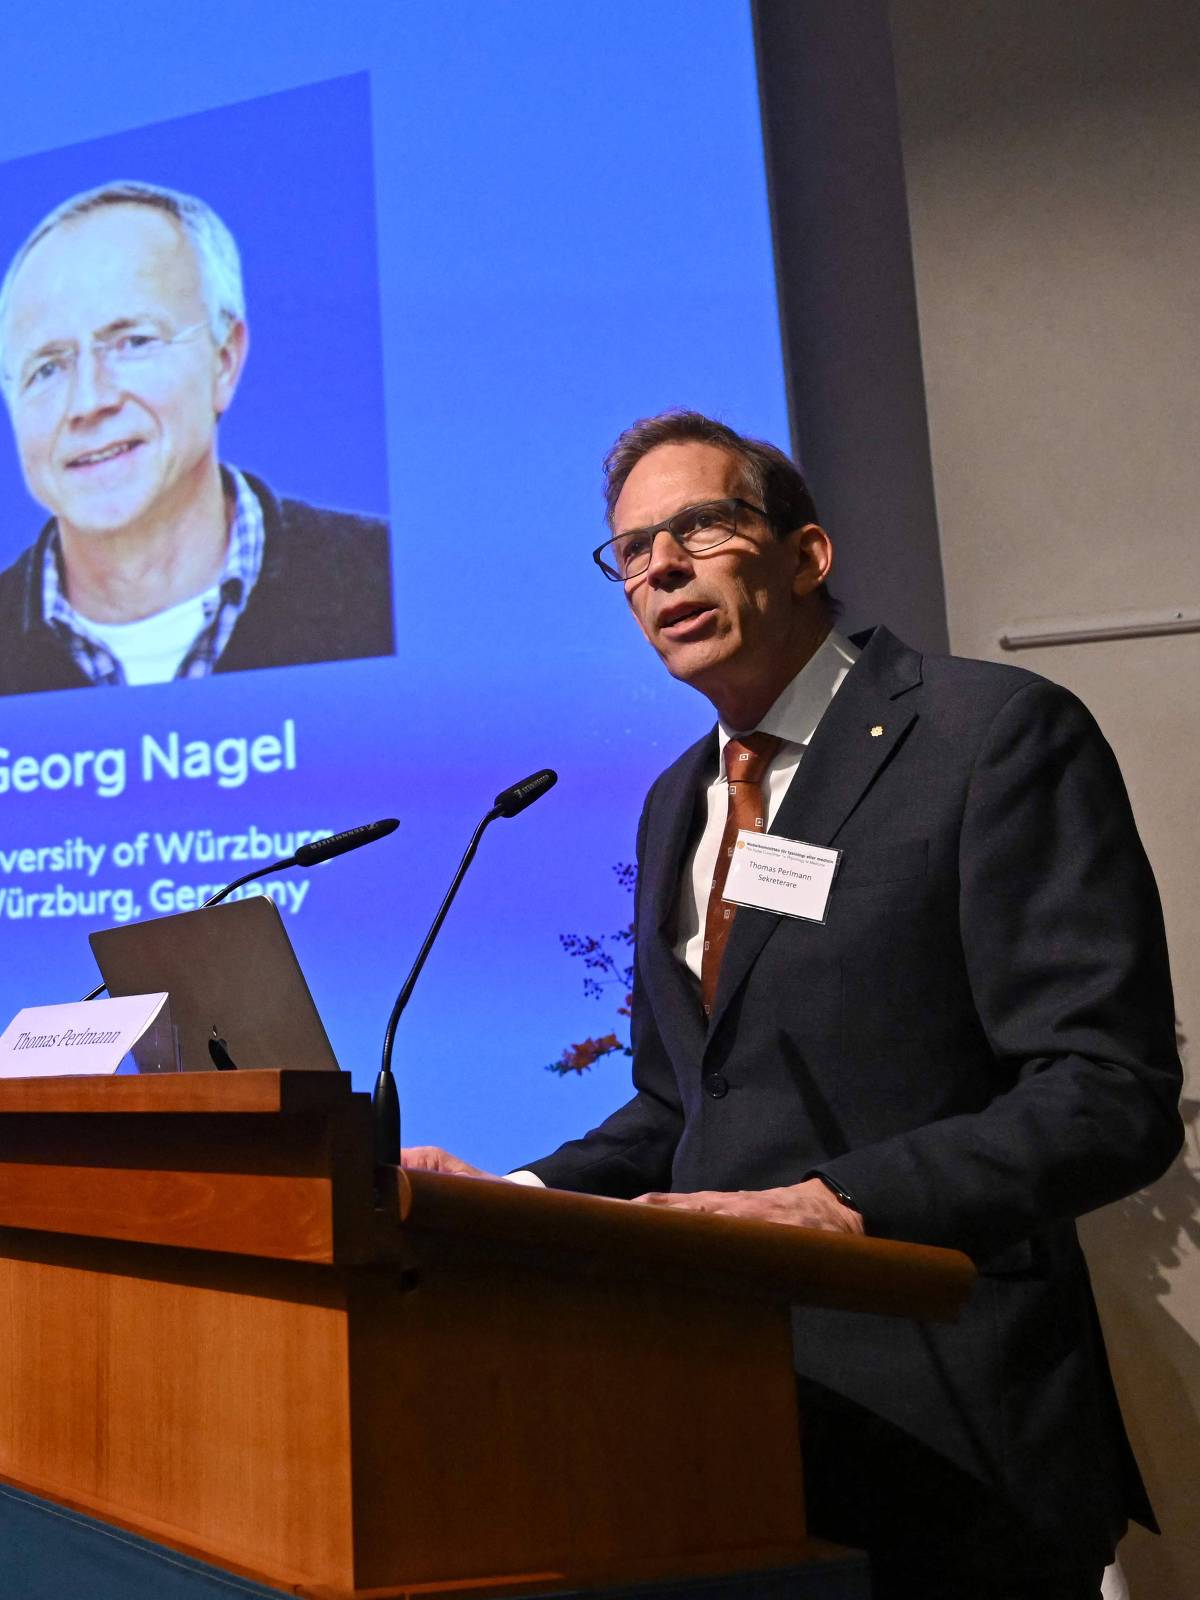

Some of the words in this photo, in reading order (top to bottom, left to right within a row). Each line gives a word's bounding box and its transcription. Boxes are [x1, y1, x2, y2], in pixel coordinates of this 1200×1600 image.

[141, 718, 297, 789] Nagel
[112, 831, 150, 867] of
[749, 860, 777, 874] Thomas
[777, 867, 812, 881] Perlmann
[758, 874, 797, 889] Sekreterare
[12, 1032, 60, 1051] Thomas
[56, 1027, 122, 1048] Perlmann
